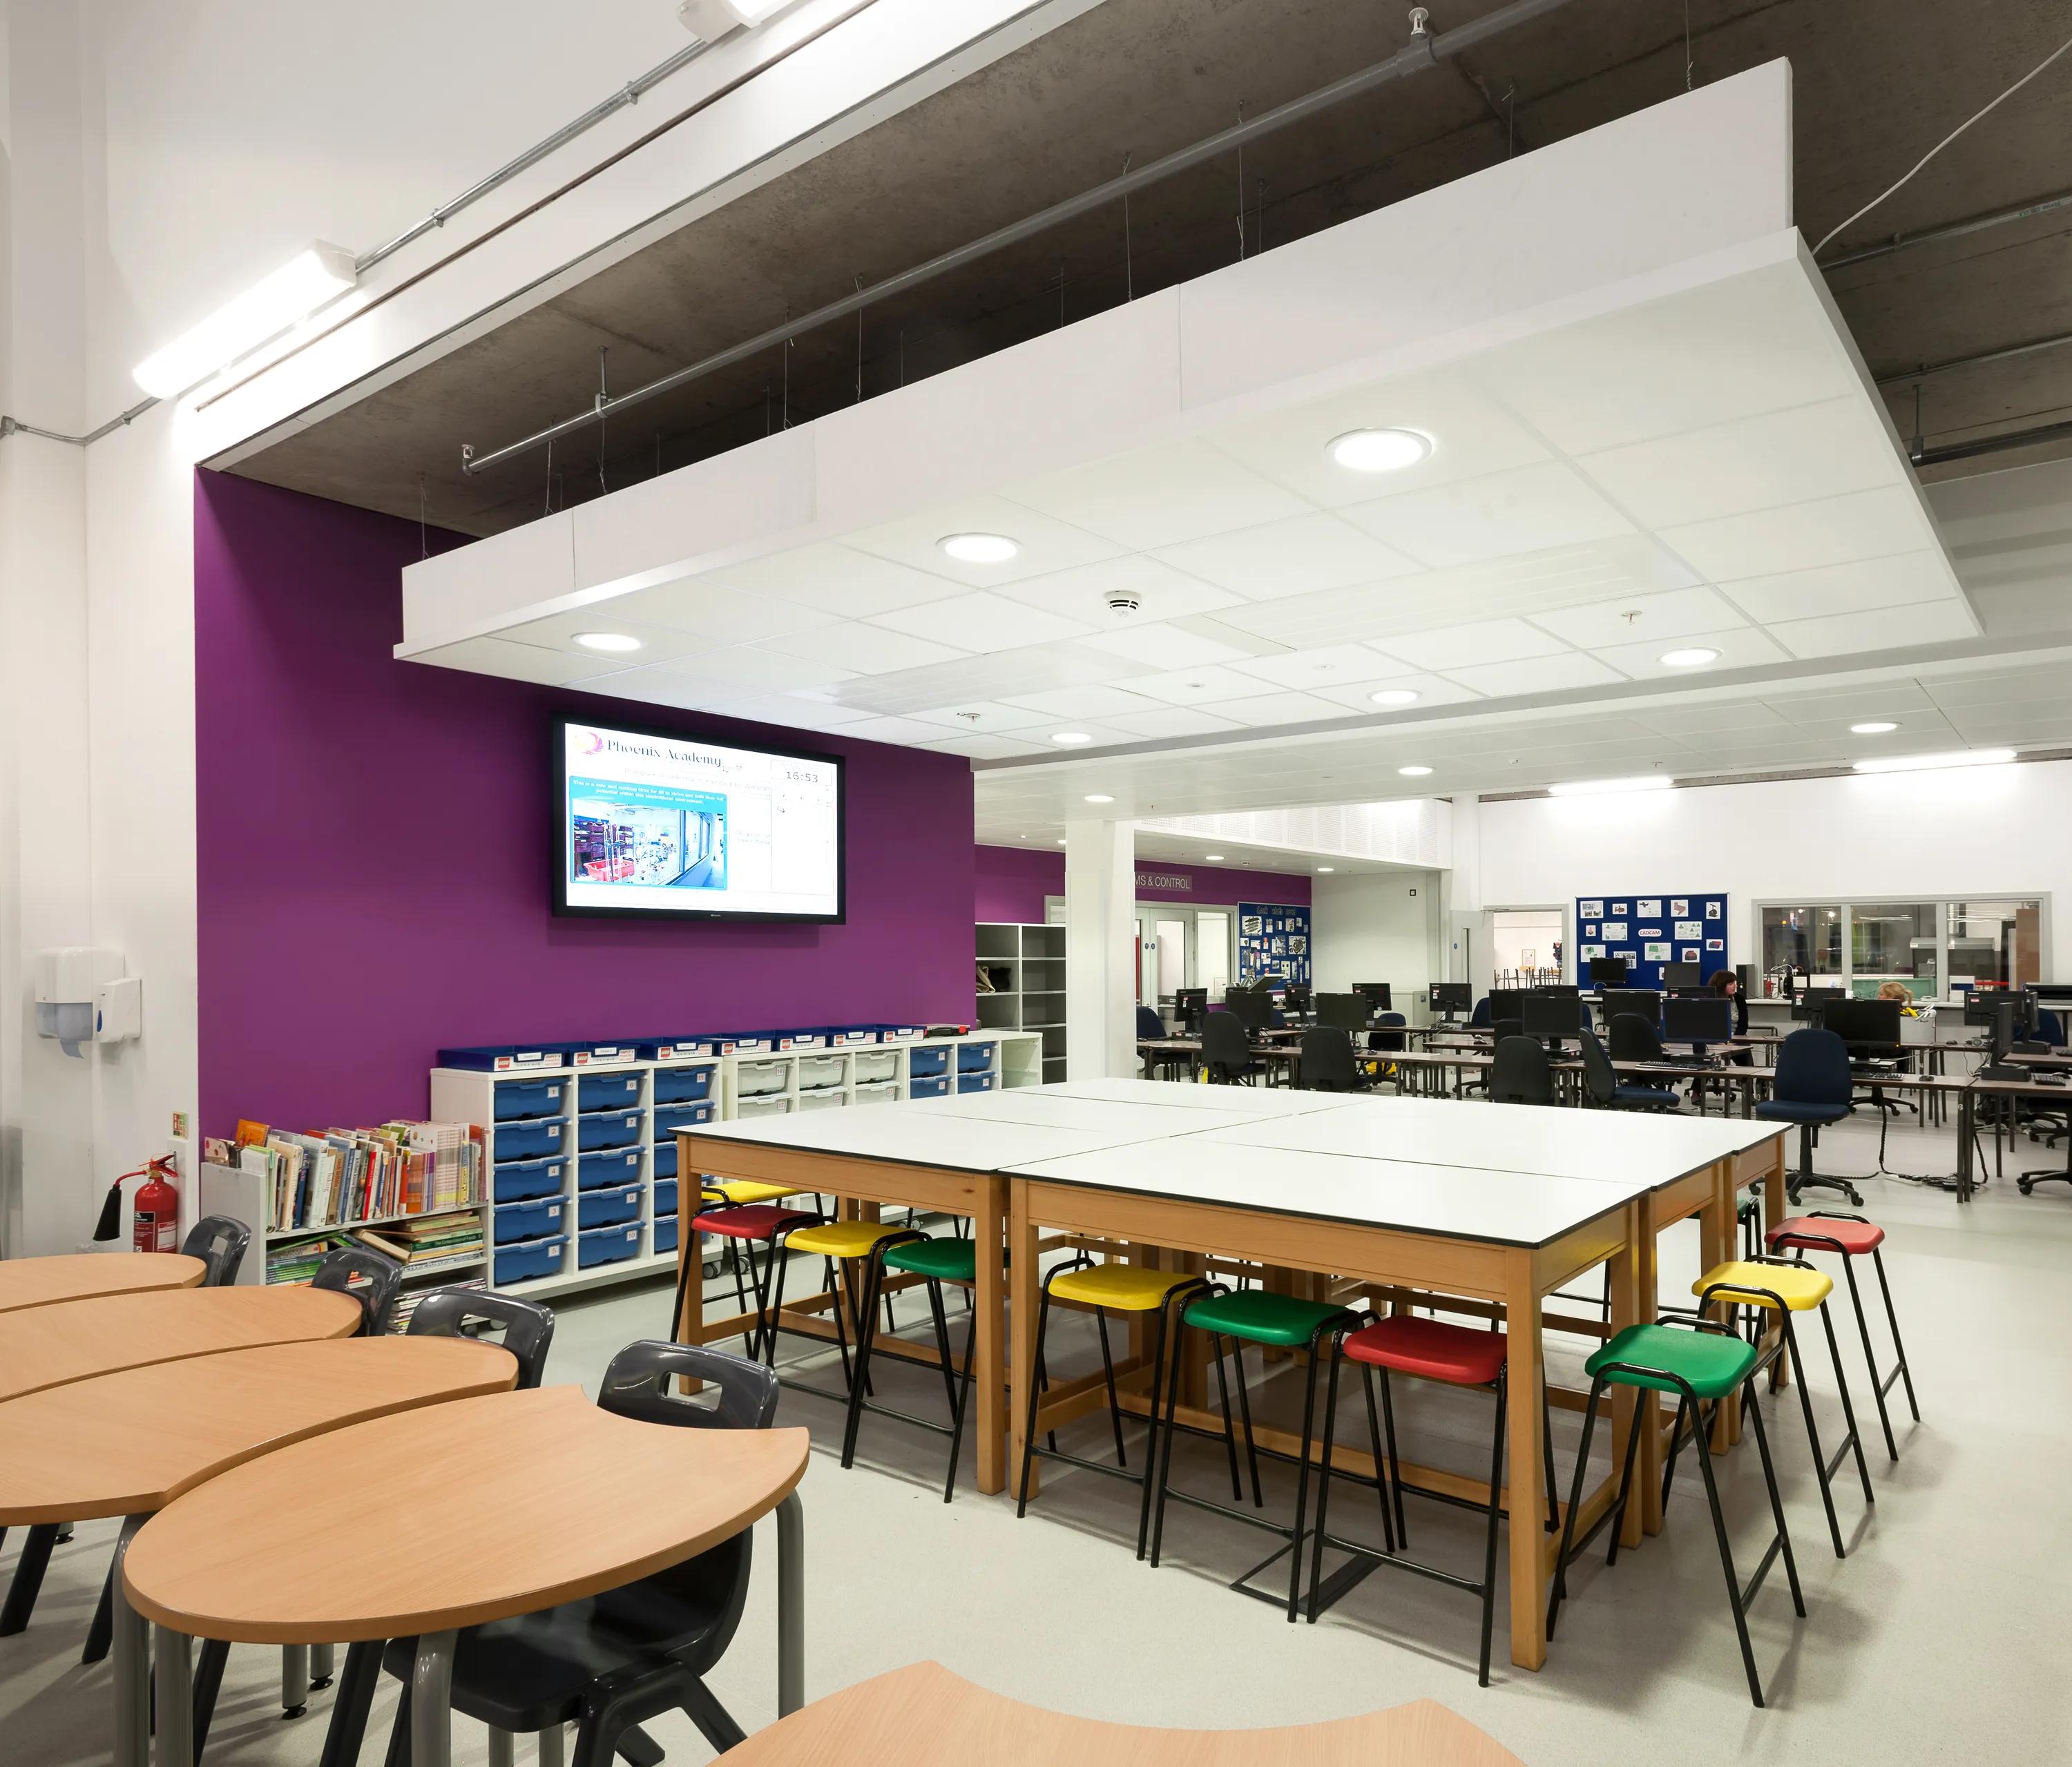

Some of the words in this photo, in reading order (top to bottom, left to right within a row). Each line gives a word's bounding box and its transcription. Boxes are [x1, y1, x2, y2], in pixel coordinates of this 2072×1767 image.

[608, 740, 660, 757] Phoenix
[666, 749, 721, 768] Academy
[787, 771, 818, 782] 16:53
[1148, 876, 1153, 886] &
[1155, 876, 1190, 889] CONTROL
